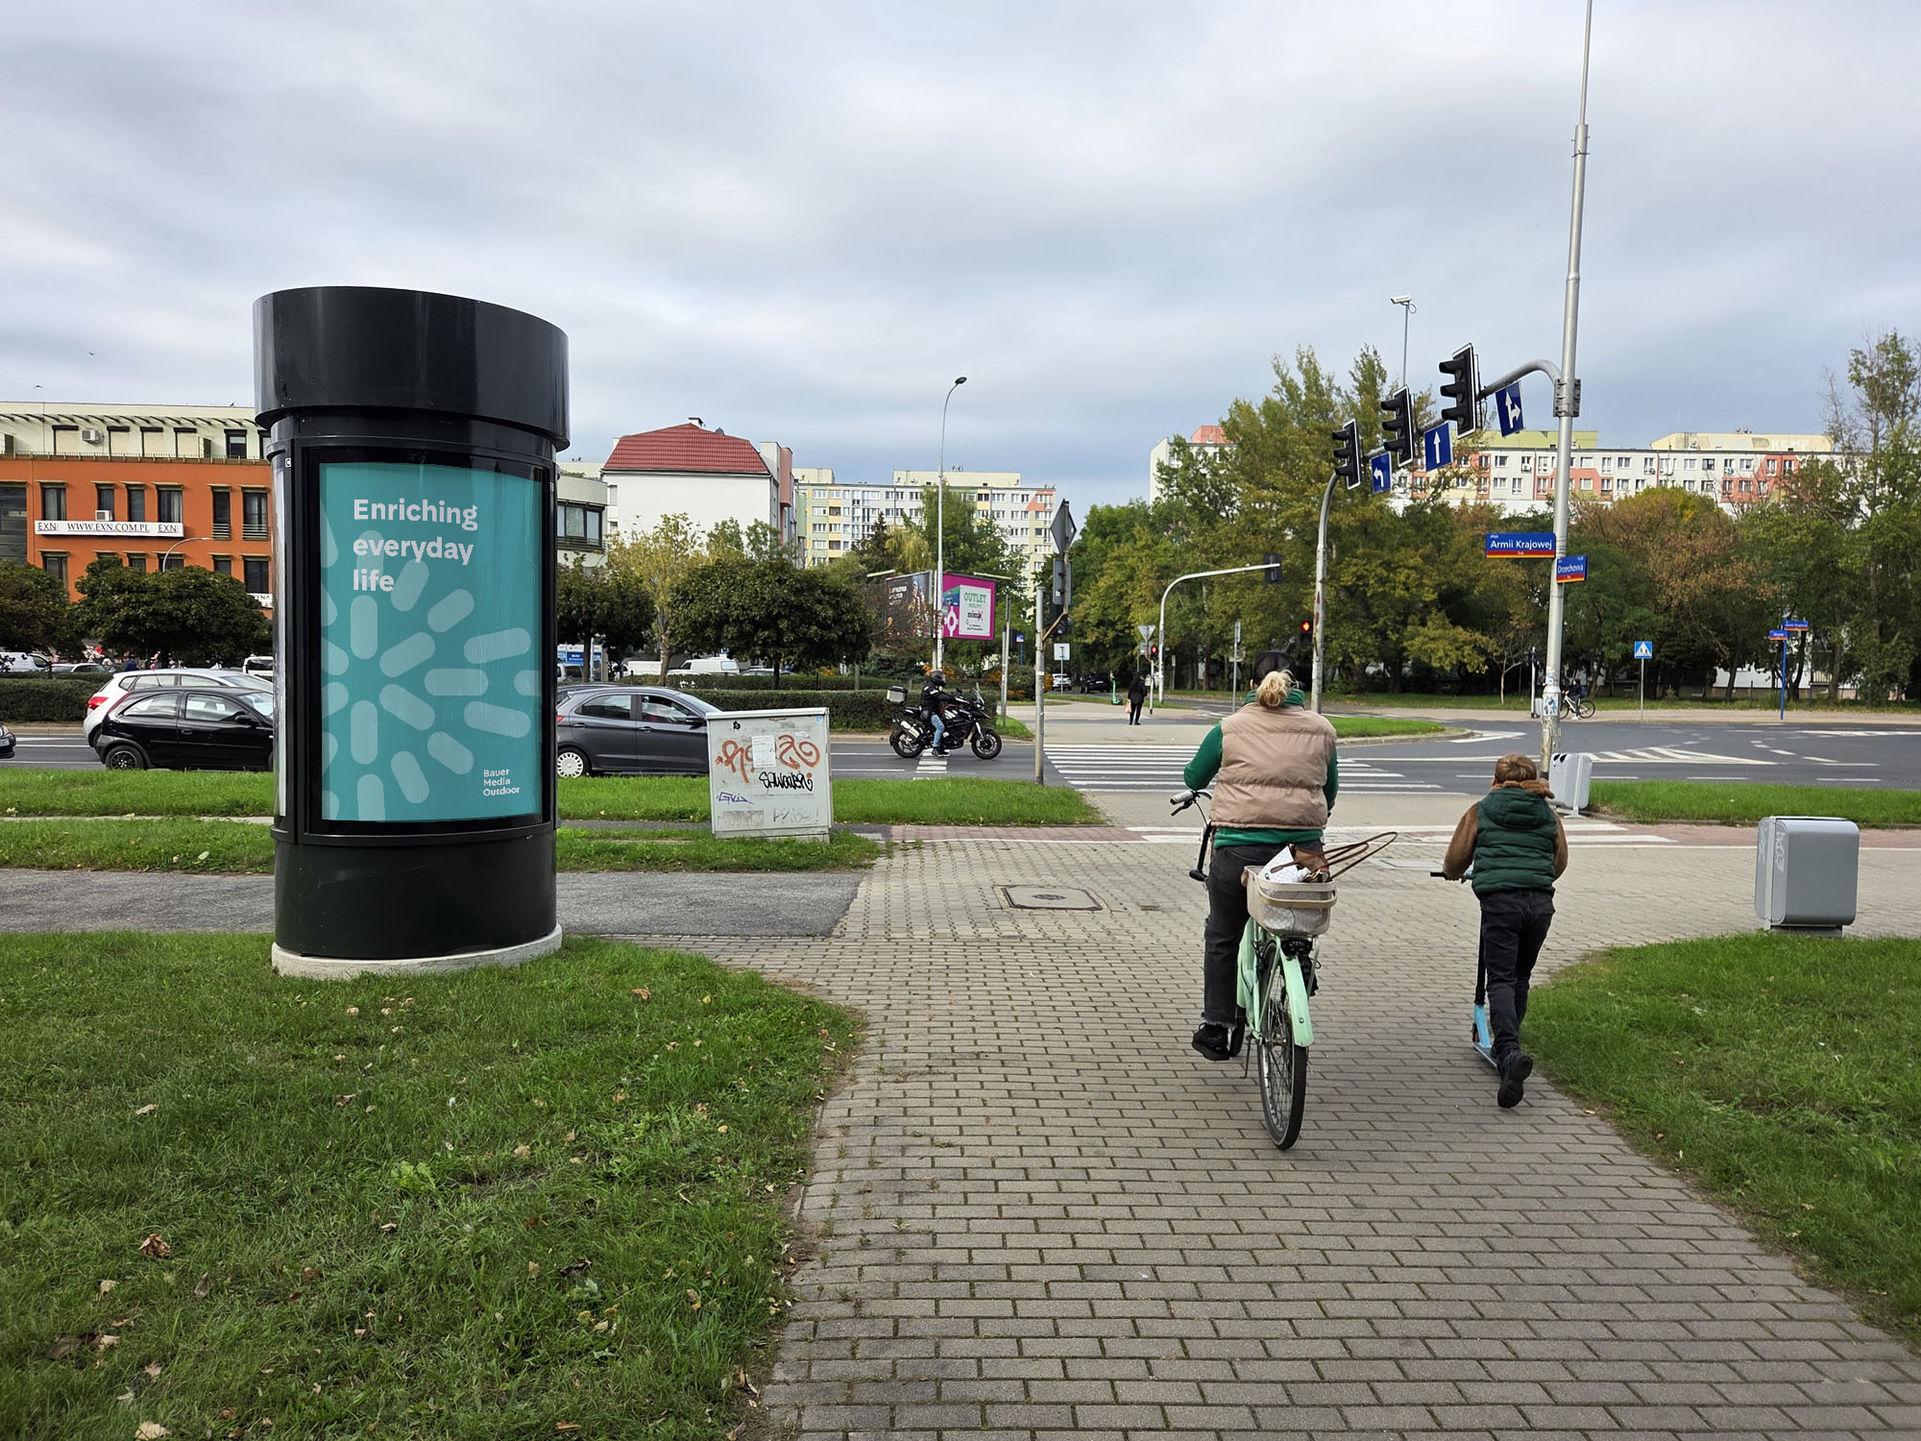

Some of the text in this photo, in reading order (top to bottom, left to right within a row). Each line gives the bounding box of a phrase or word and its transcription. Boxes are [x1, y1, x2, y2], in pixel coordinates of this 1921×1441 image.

[353, 498, 478, 531] Enriching
[37, 522, 177, 533] EXN WWW.EXN.COM.PL EXN
[353, 536, 474, 566] everyday
[1490, 540, 1552, 551] Armii Krajowej
[353, 568, 395, 592] life
[483, 769, 510, 777] Bauer
[483, 777, 511, 786] Media
[482, 787, 521, 796] Outdoor
